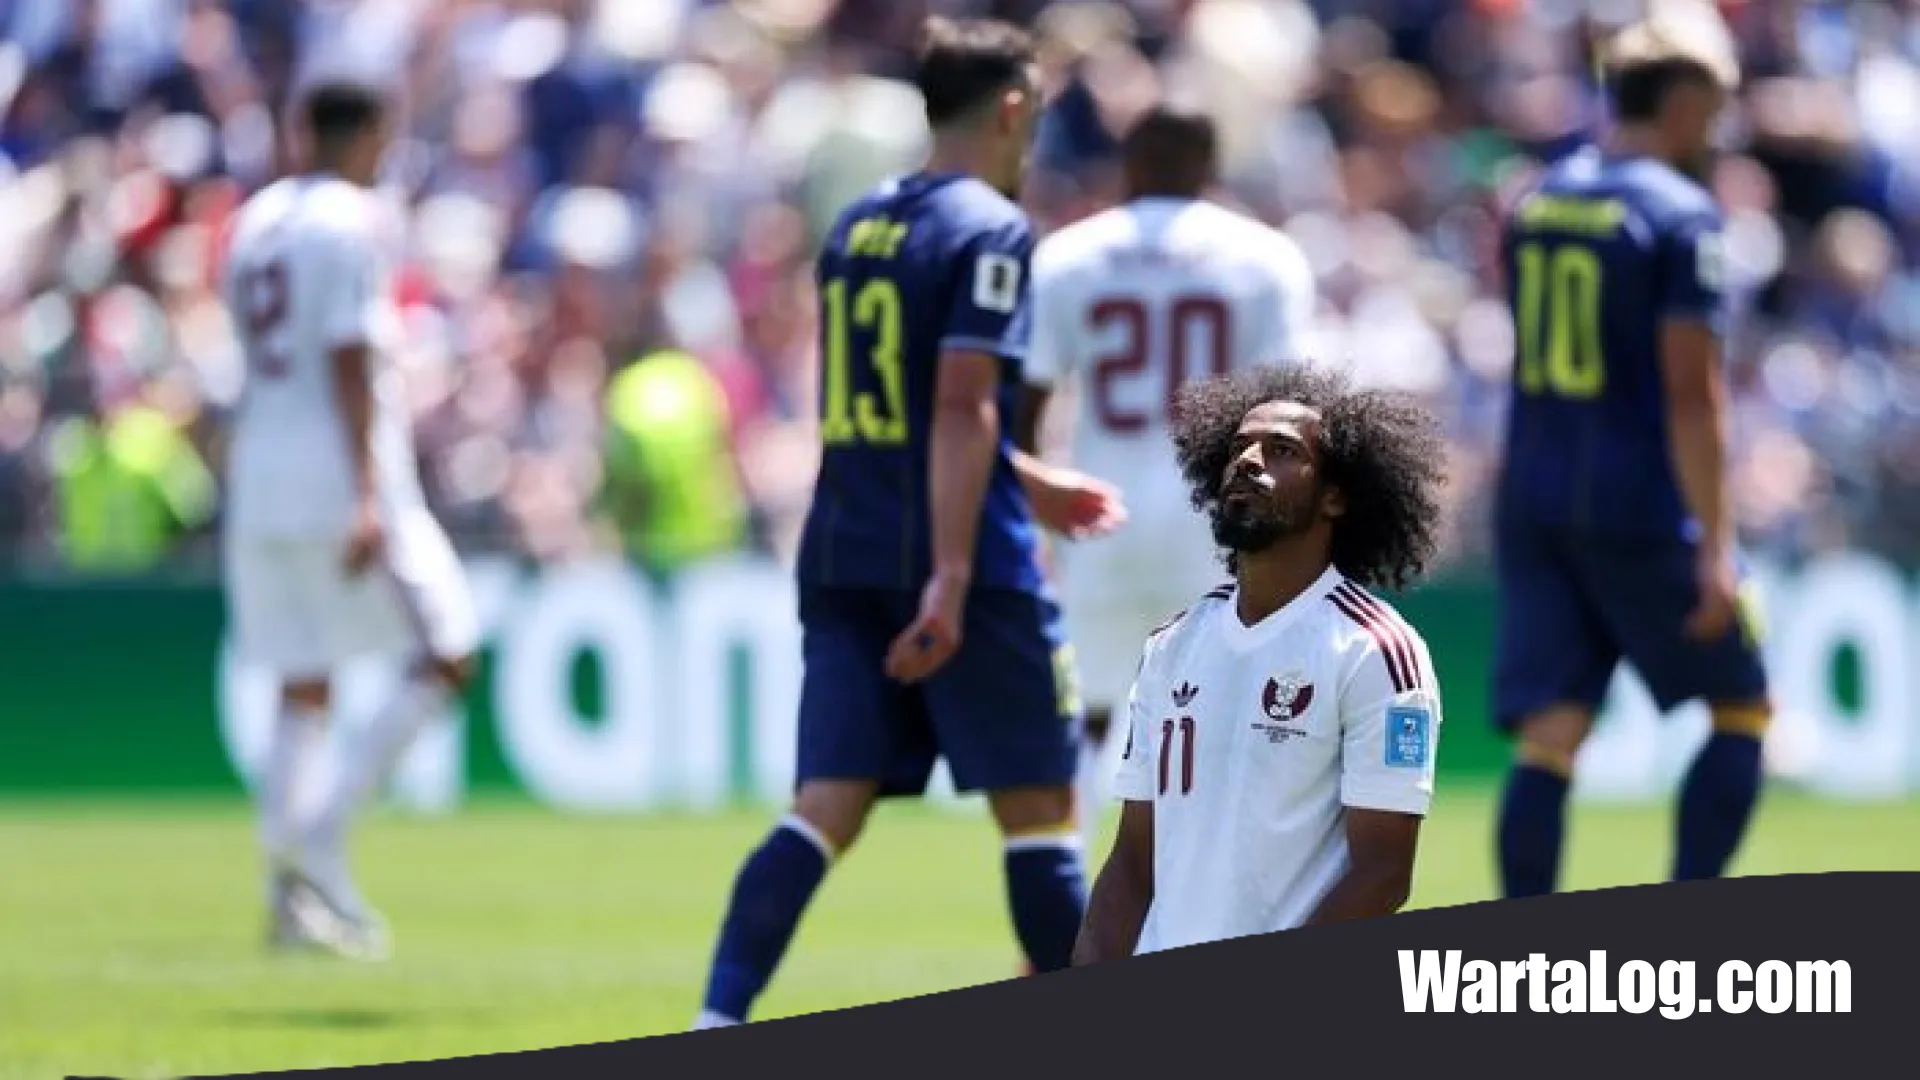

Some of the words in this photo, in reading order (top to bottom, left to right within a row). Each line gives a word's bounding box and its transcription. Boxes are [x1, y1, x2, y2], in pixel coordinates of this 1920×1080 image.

[820, 275, 907, 441] 13
[1088, 293, 1232, 430] 20
[1517, 244, 1605, 393] 10
[1158, 716, 1196, 796] 11
